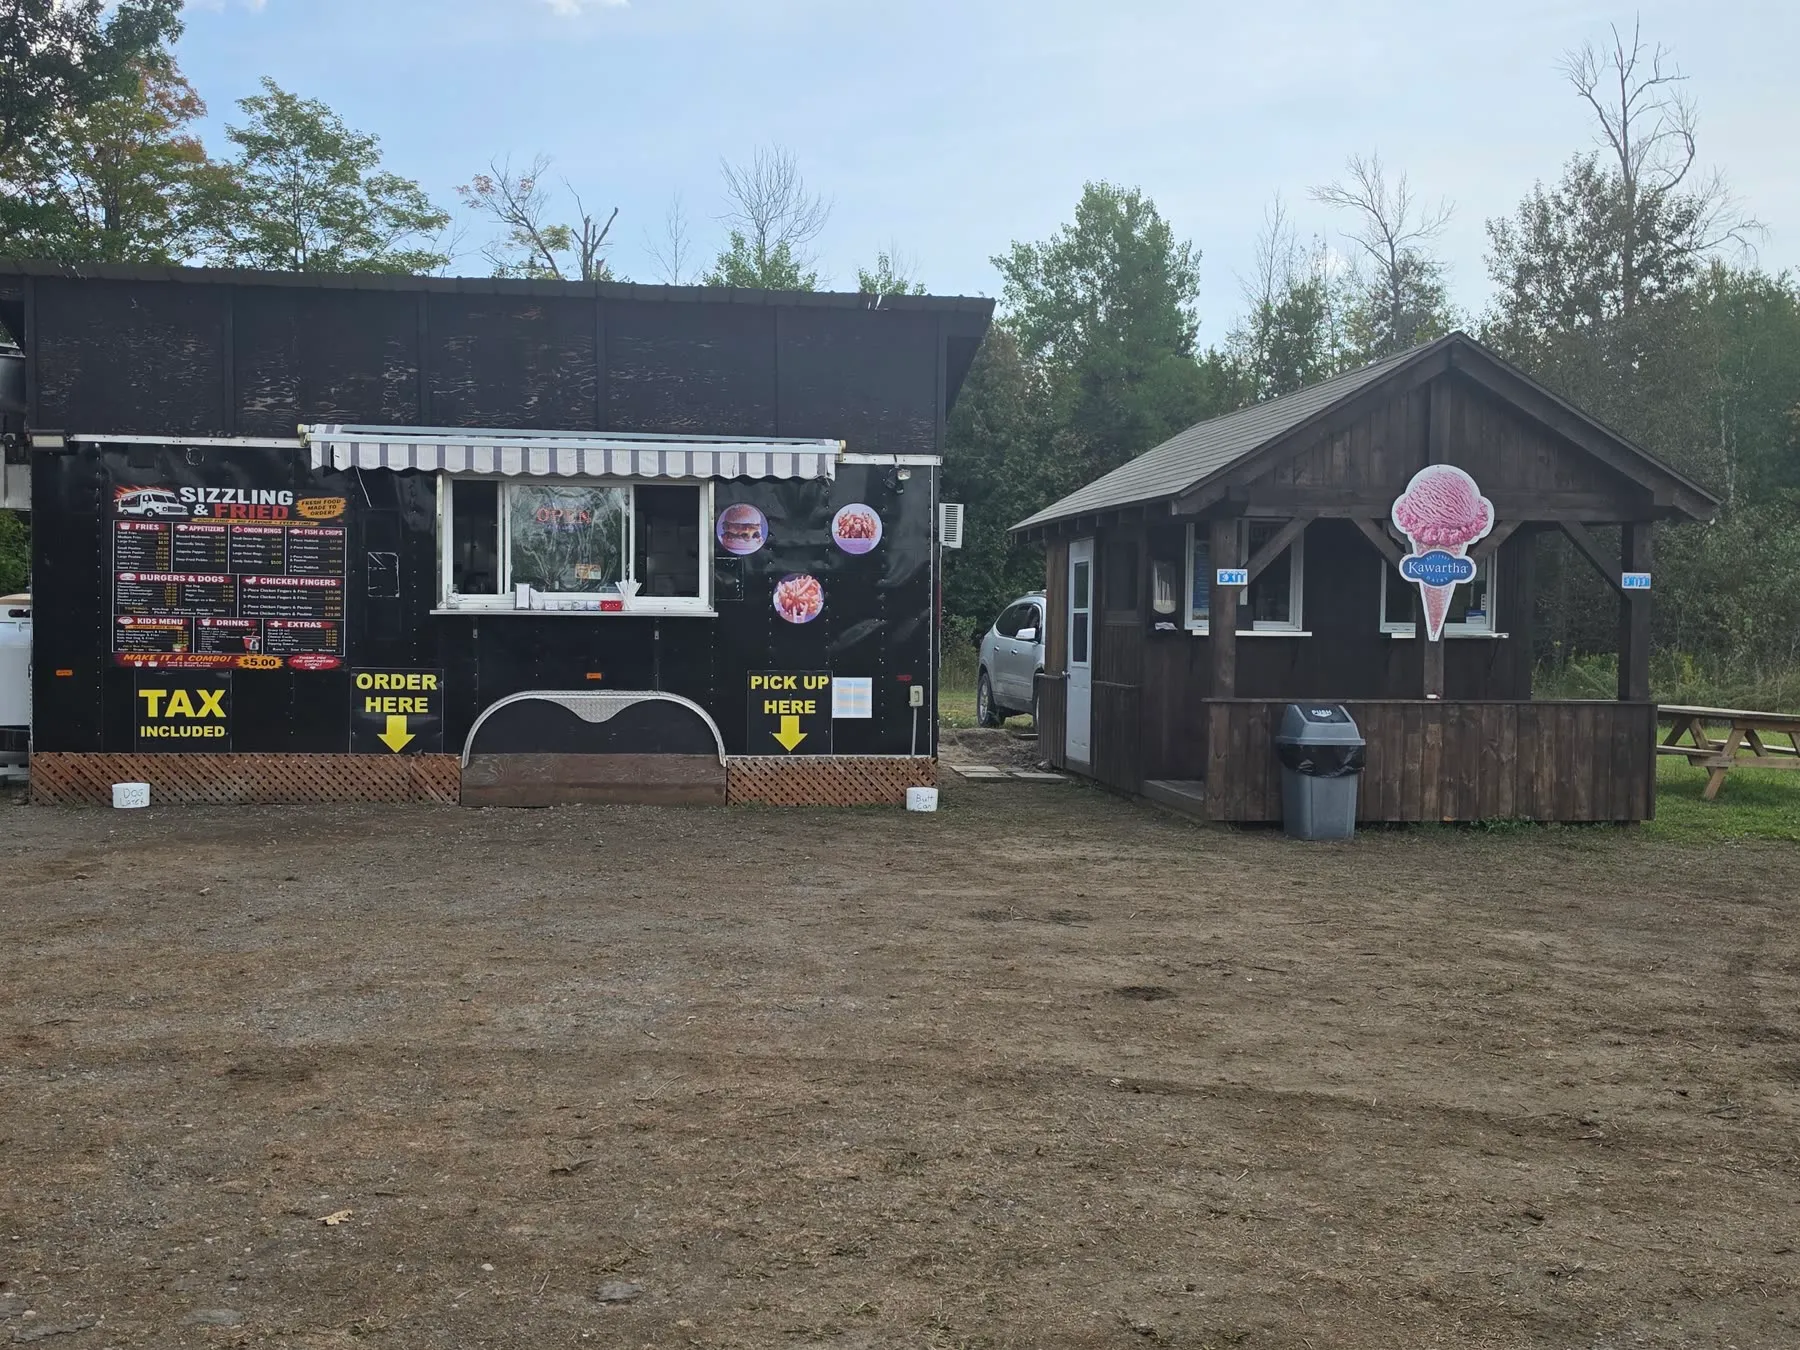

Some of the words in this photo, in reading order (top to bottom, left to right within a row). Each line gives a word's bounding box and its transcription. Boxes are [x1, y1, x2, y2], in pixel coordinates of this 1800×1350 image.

[179, 487, 293, 505] SIZZLING
[194, 505, 209, 516] &
[214, 504, 288, 520] FRIED
[536, 508, 591, 524] OPEN
[1408, 562, 1467, 575] Kawartha
[140, 574, 185, 582] BURGERS
[260, 577, 298, 585] CHICKEN
[300, 578, 336, 586] FINGERS
[243, 659, 276, 667] $5.00
[356, 673, 437, 690] ORDER
[751, 675, 797, 690] PICK
[803, 675, 829, 690] UP
[138, 689, 226, 718] TAX
[365, 697, 428, 713] HERE
[764, 700, 816, 714] HERE
[140, 726, 225, 738] INCLUDED
[916, 793, 934, 802] Butt
